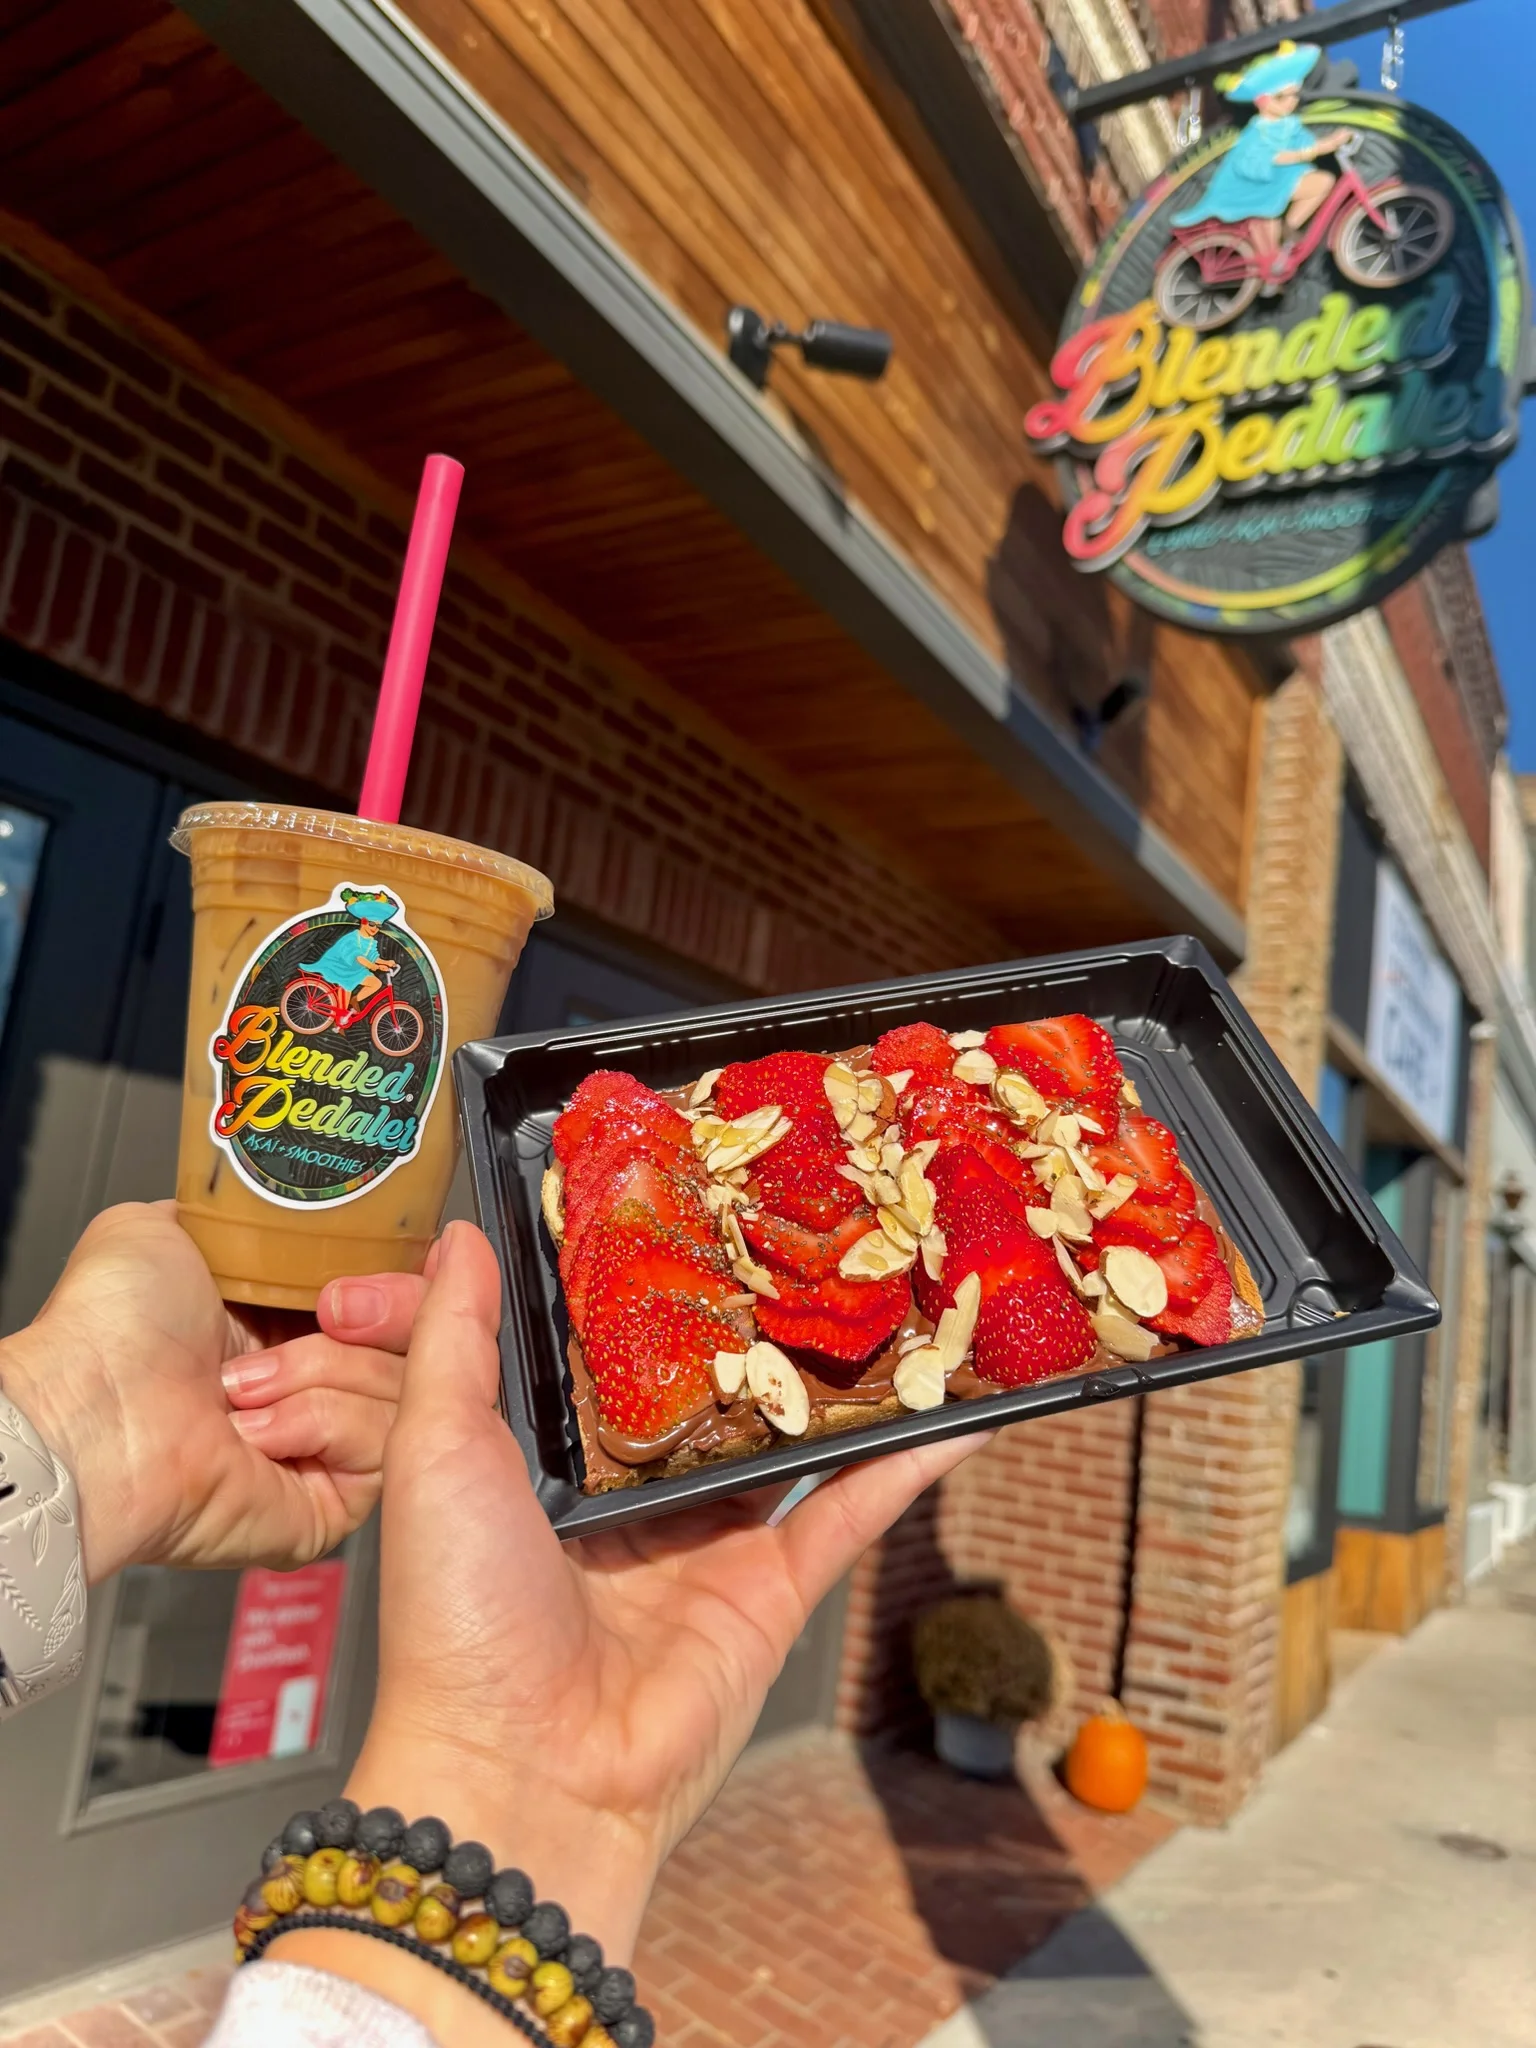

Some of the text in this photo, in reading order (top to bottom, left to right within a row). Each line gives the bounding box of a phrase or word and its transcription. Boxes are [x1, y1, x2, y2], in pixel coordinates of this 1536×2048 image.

[1025, 272, 1460, 443] Blended
[1062, 364, 1512, 560] Pedaler
[214, 1005, 415, 1102] Blended
[214, 1075, 419, 1153] Pedaler
[284, 1145, 367, 1173] SMOOTHIES
